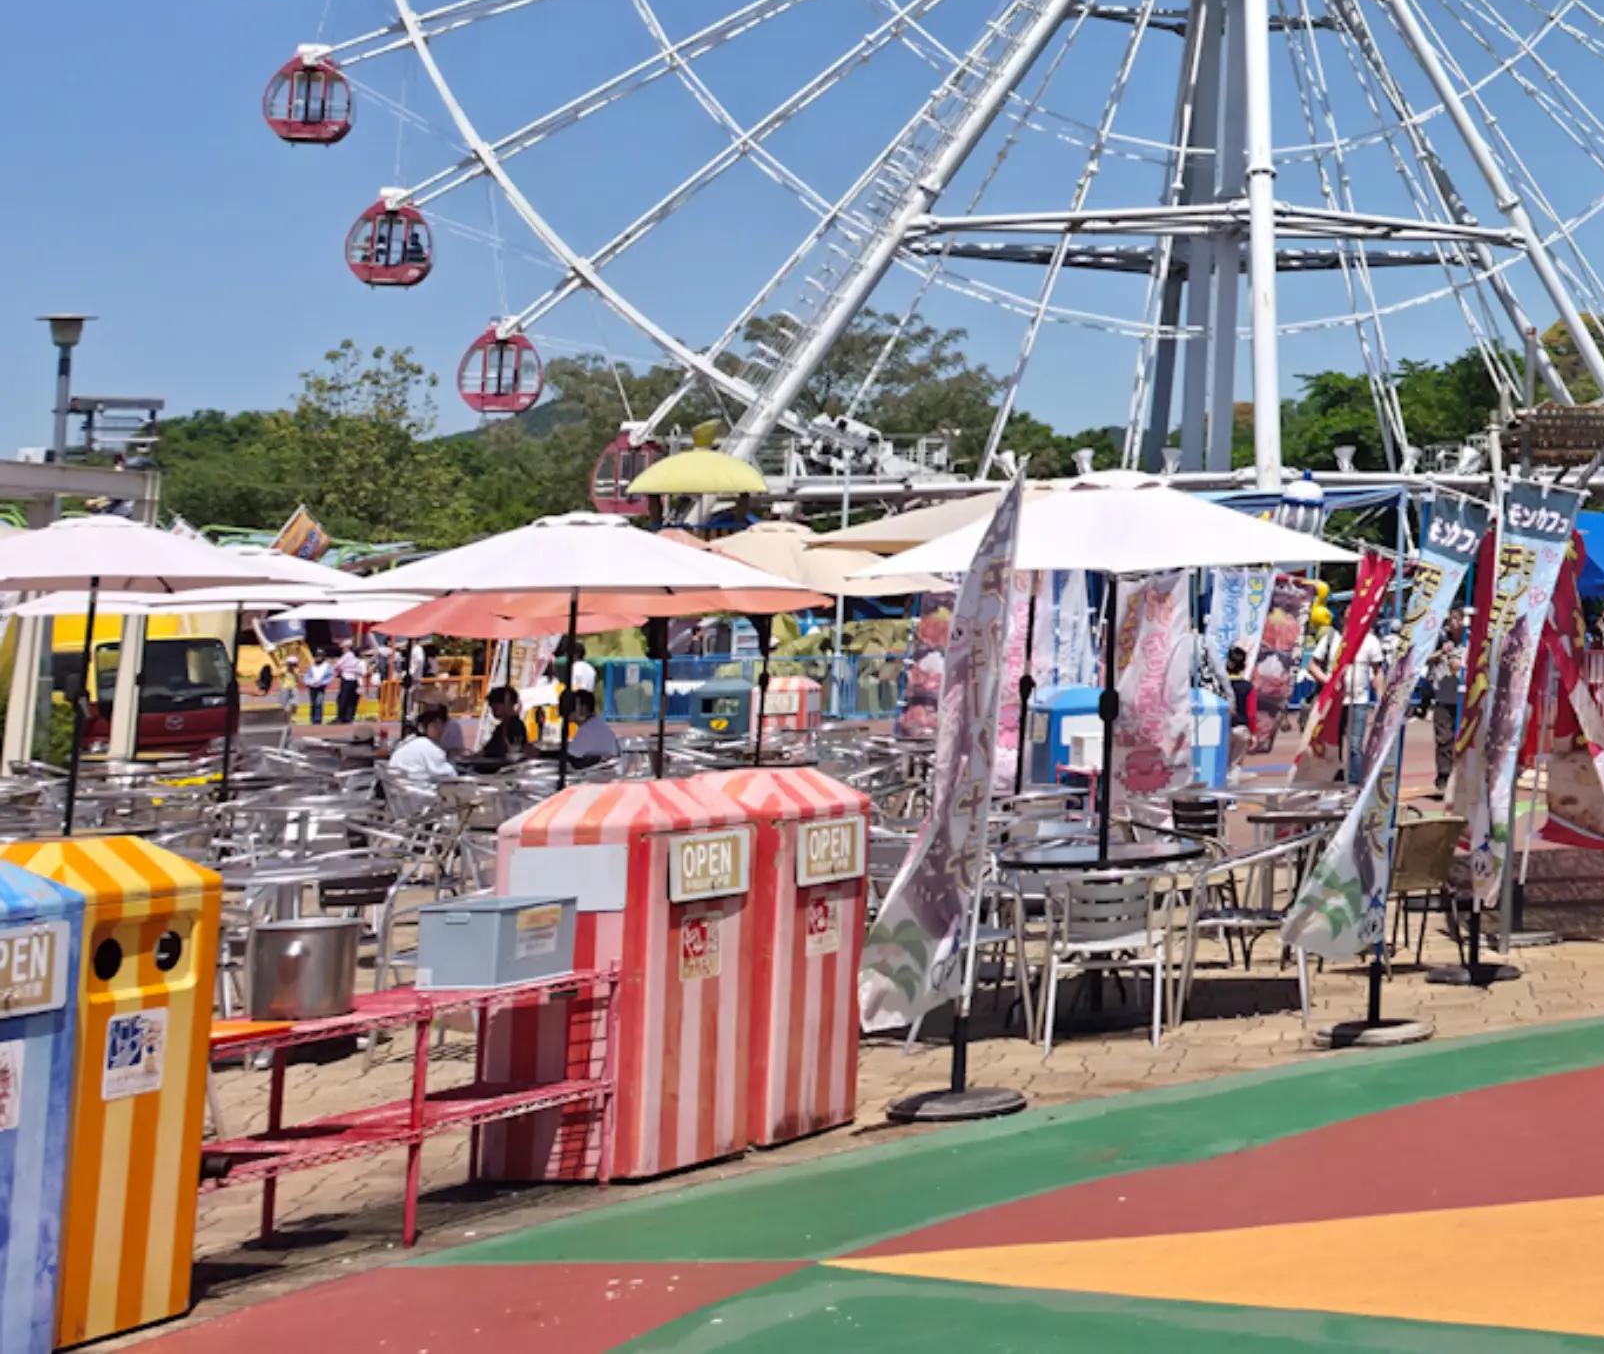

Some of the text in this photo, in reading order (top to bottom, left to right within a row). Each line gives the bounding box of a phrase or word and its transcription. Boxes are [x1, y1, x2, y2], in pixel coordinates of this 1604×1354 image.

[682, 841, 732, 879] OPEN
[810, 826, 851, 861] OPEN
[0, 934, 50, 982] PEN
